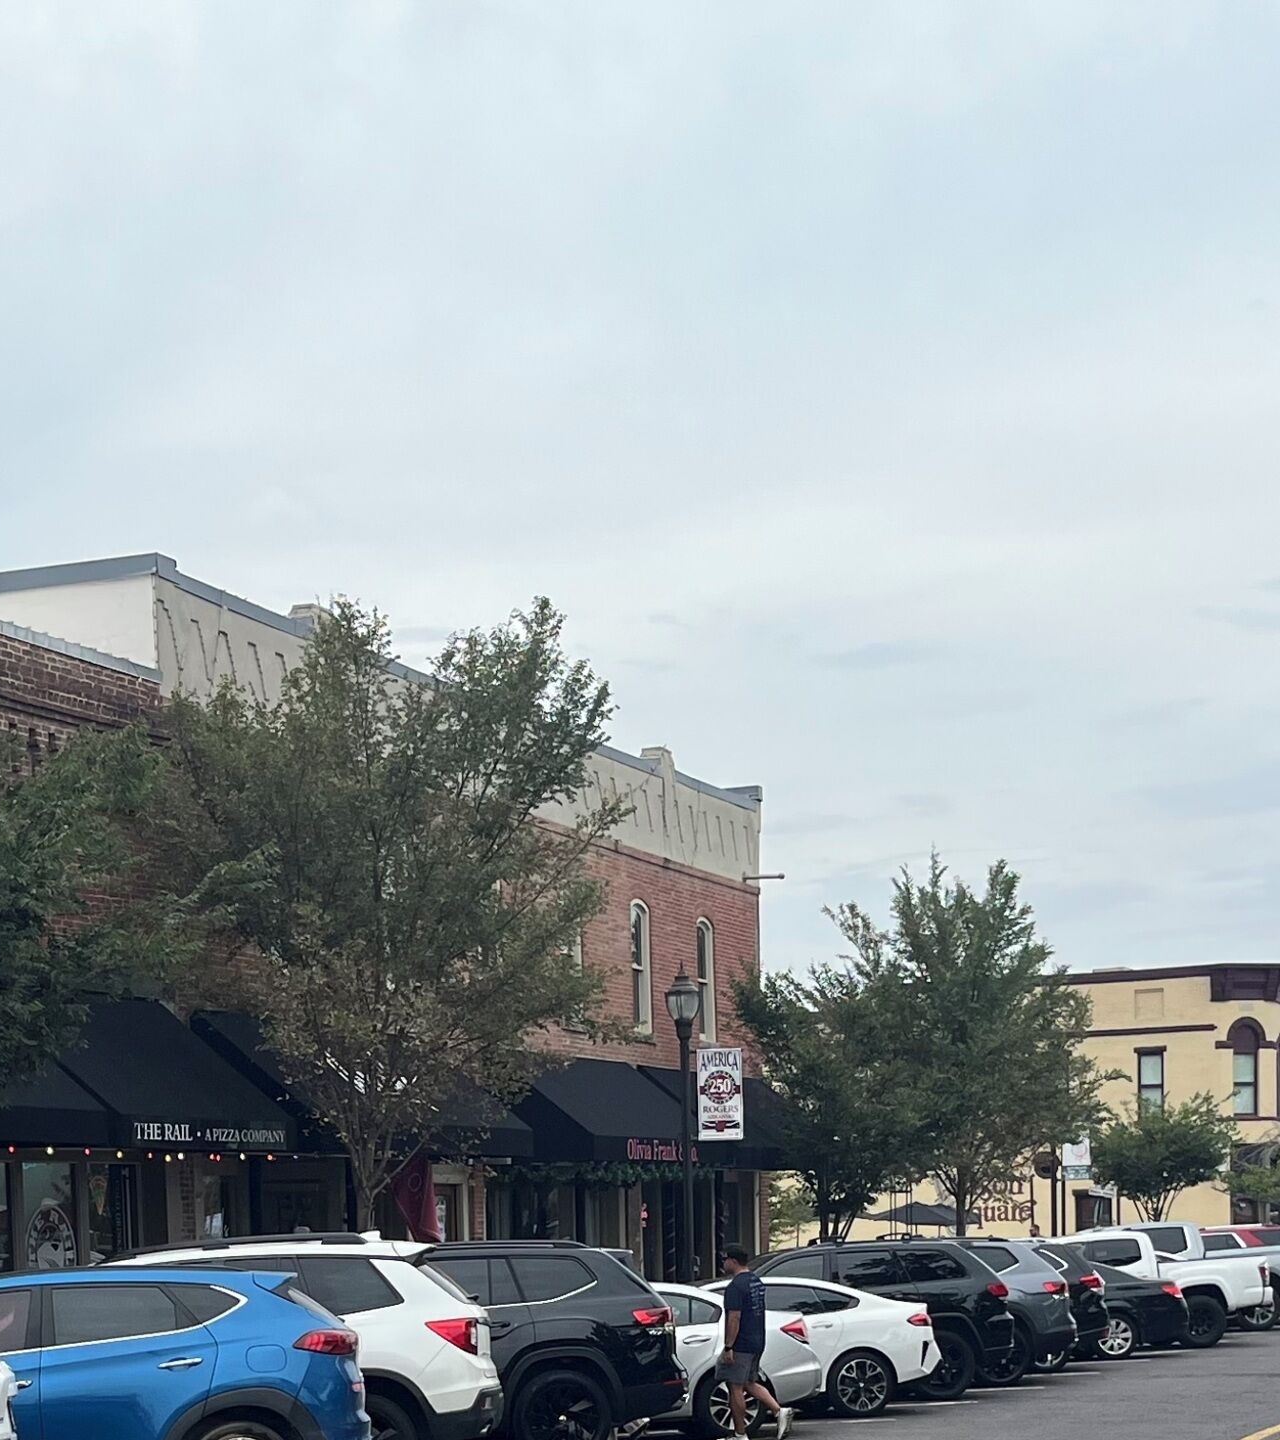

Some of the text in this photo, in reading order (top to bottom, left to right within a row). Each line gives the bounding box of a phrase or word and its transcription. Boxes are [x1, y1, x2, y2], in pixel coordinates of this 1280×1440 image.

[700, 1051, 739, 1072] AMERICA
[709, 1079, 731, 1093] 250
[703, 1104, 739, 1114] ROGERS
[134, 1122, 286, 1143] THE RAIL A PIZZA COMPANY
[627, 1138, 652, 1160] Olivia
[653, 1140, 678, 1161] Frank
